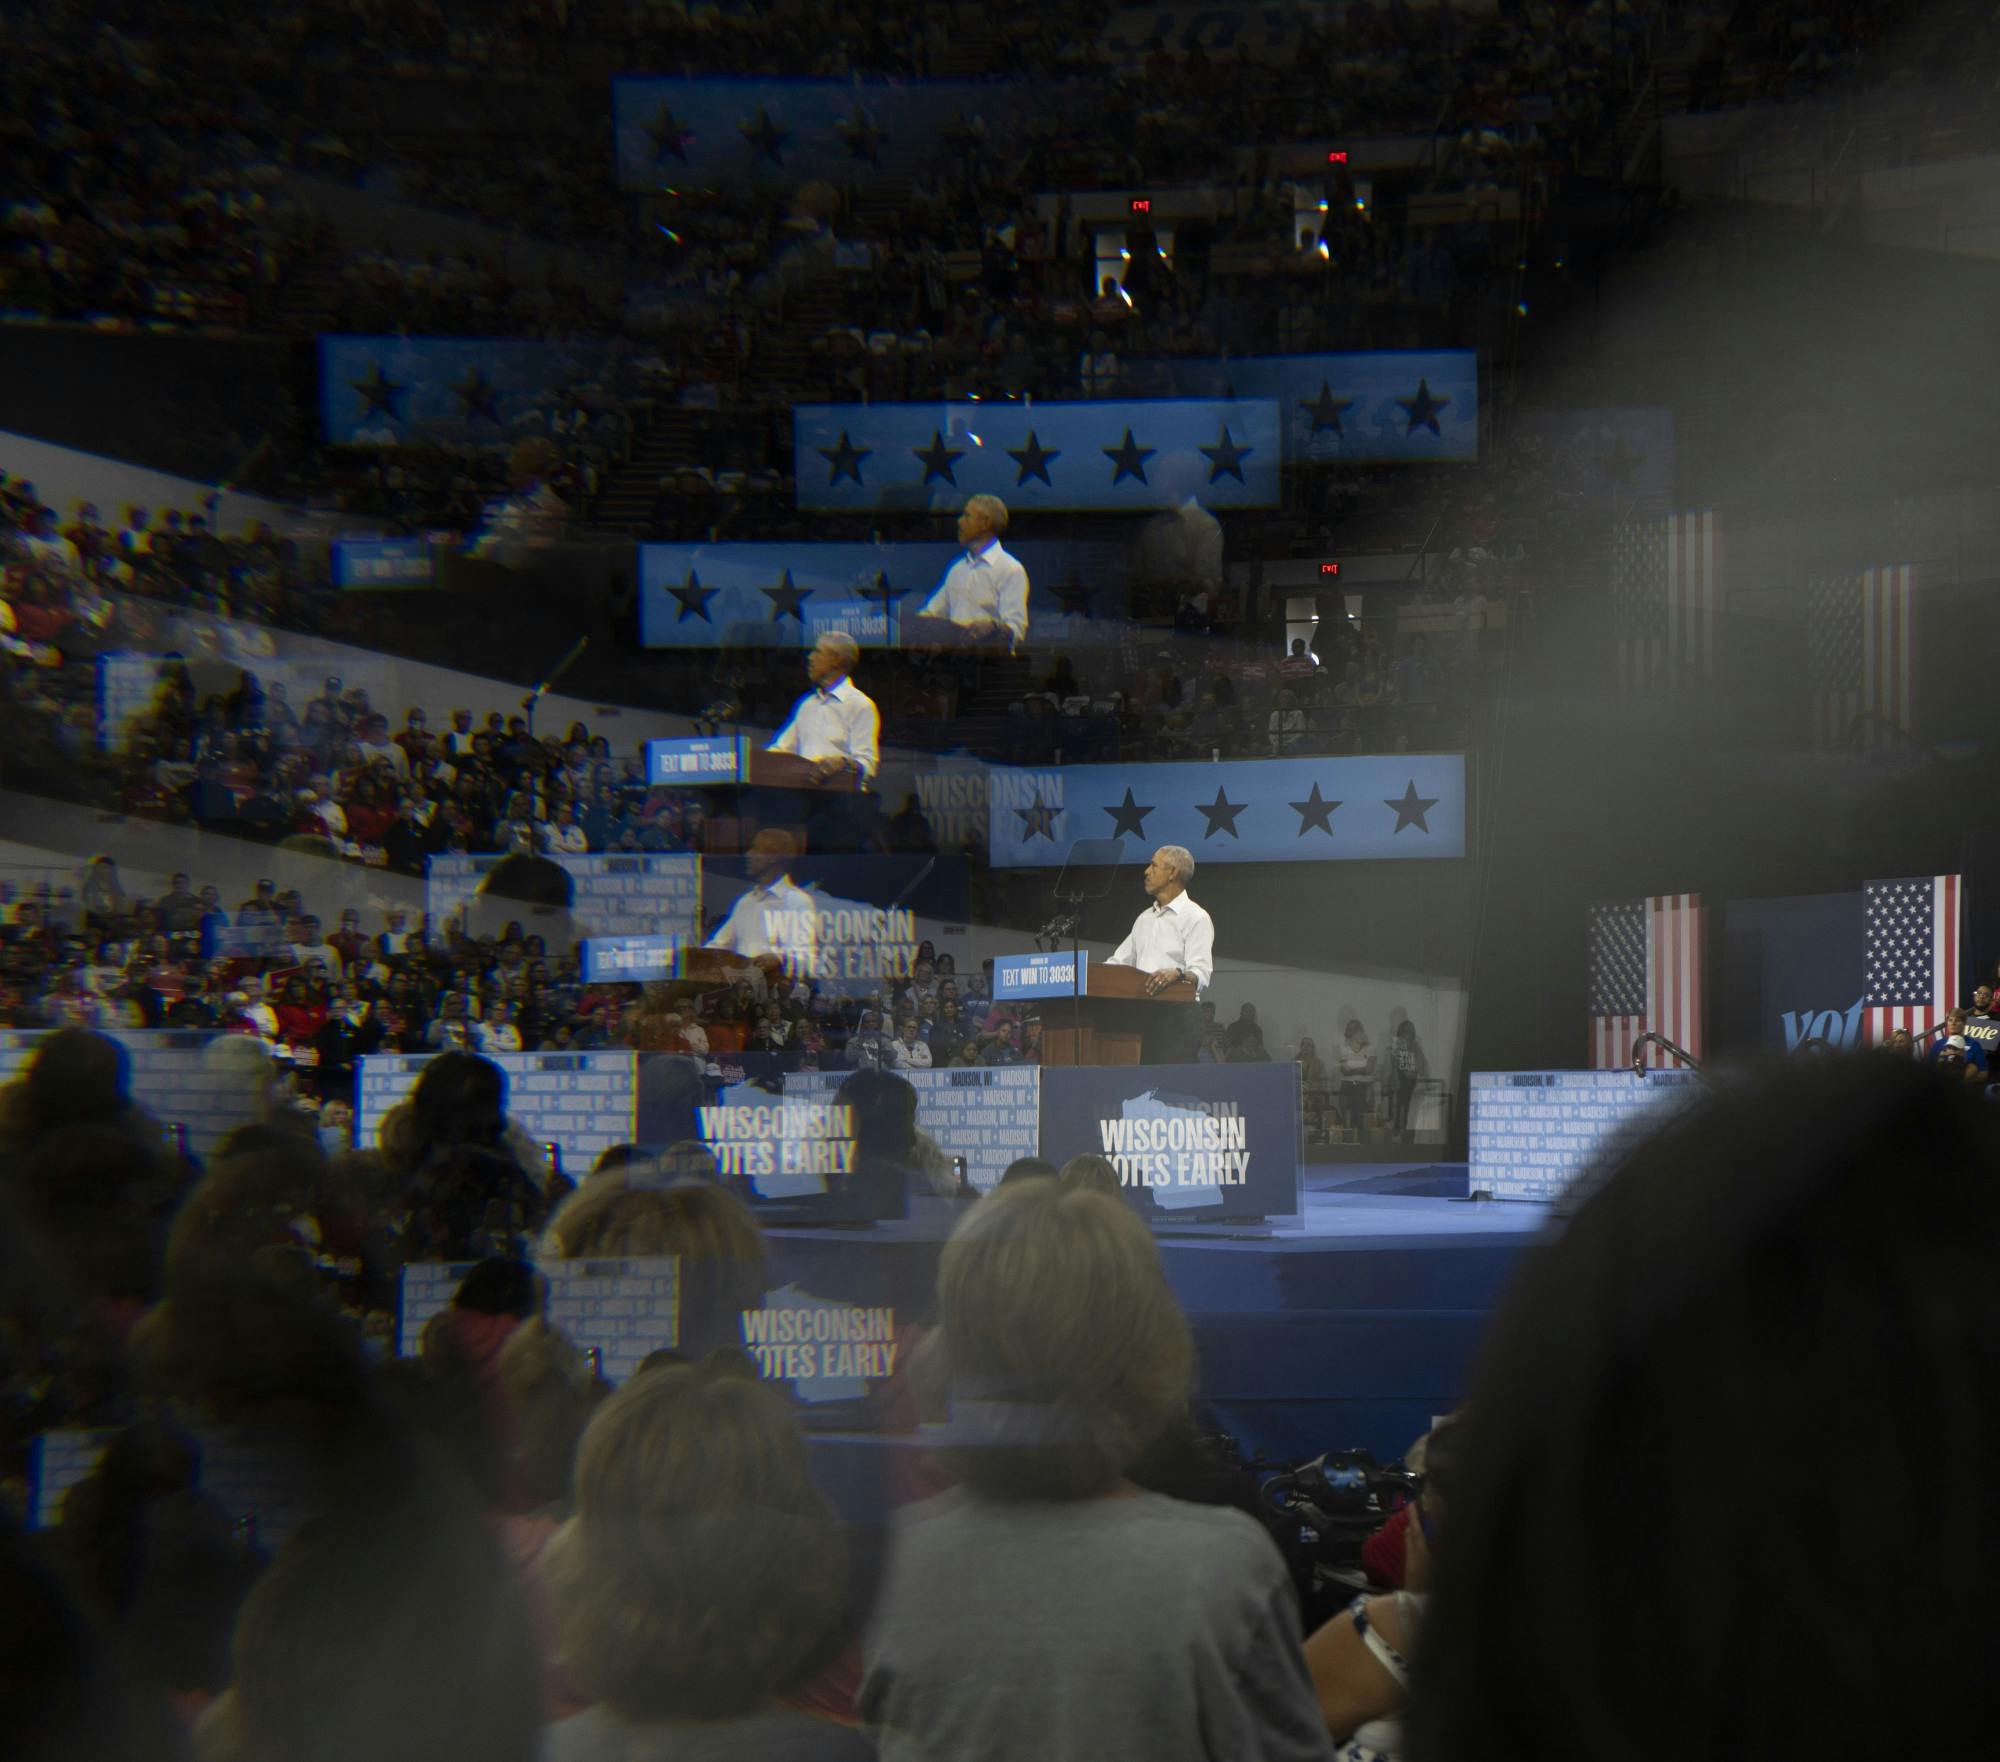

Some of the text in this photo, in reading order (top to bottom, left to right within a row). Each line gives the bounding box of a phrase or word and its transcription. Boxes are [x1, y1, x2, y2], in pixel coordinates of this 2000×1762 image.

[1322, 564, 1338, 575] EXIT
[921, 811, 988, 847] OTES
[763, 909, 916, 944] WISCONSIN
[770, 944, 919, 979] OTES EARLY
[1003, 969, 1019, 986] TEXT
[1021, 967, 1037, 985] WIN
[1039, 966, 1048, 984] TO
[1781, 996, 1864, 1053] vot
[1963, 1025, 1999, 1040] vote
[951, 1071, 982, 1088] MADISON,
[984, 1071, 993, 1086] WI
[695, 1105, 854, 1139] WISCONSIN
[1100, 1117, 1246, 1152] WISCONSIN
[705, 1140, 857, 1175] OTES EARLY
[1106, 1152, 1250, 1187] OTES EARLY
[739, 1308, 895, 1343] WISCONSIN
[747, 1343, 898, 1379] OTES EARLY
